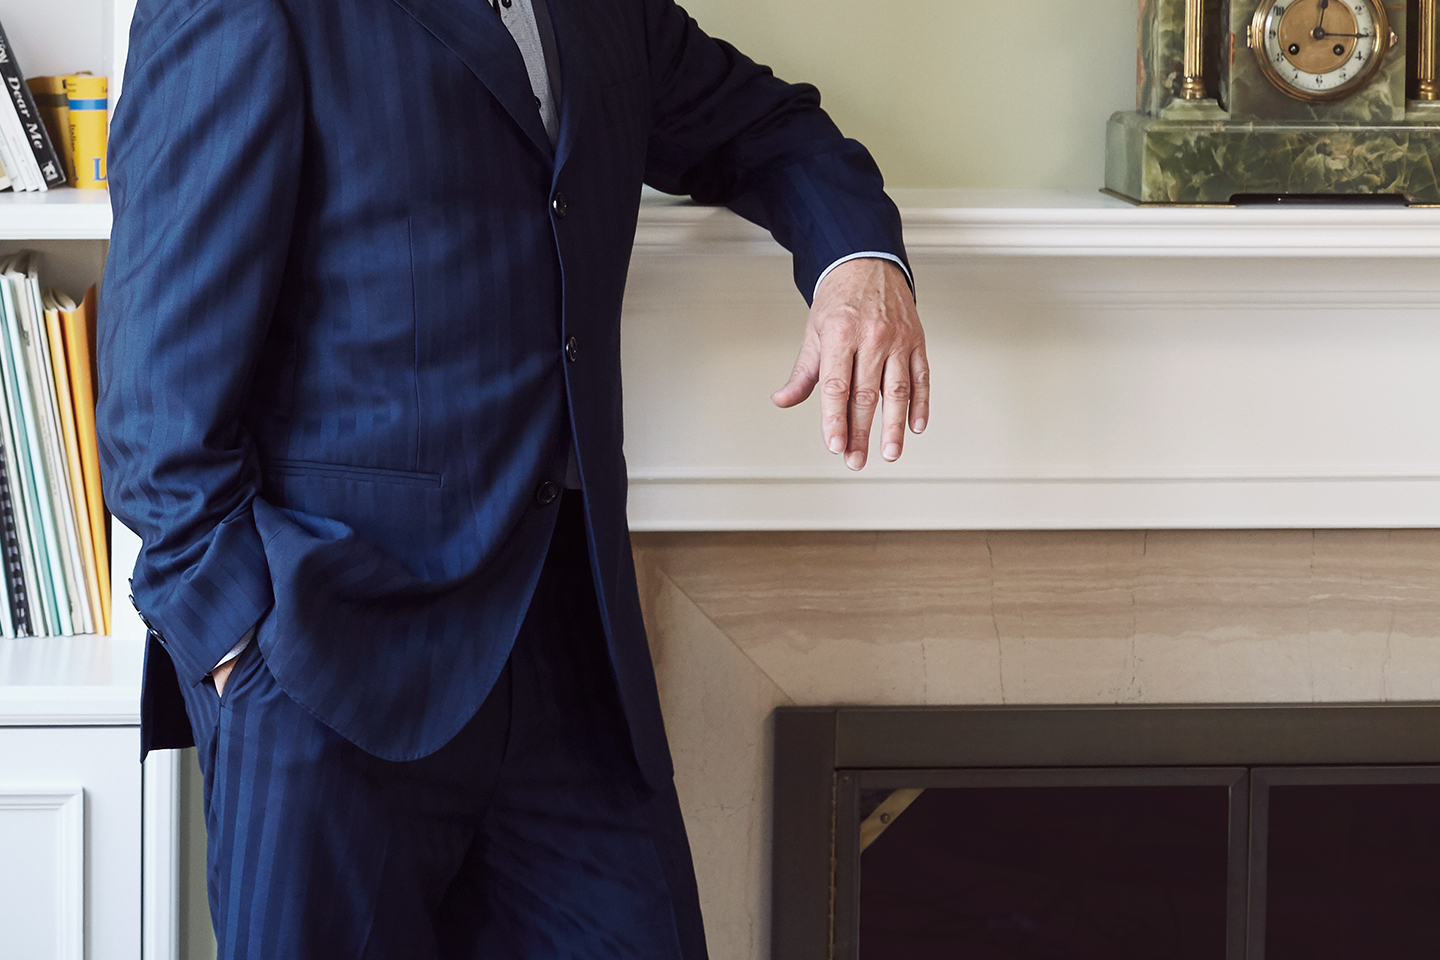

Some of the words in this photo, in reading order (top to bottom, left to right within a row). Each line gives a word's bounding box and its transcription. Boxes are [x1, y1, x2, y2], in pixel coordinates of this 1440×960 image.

[1268, 31, 1276, 40] 9
[1355, 50, 1366, 61] 4
[1315, 74, 1324, 84] 6
[7, 76, 30, 118] Dear
[26, 122, 44, 149] Me
